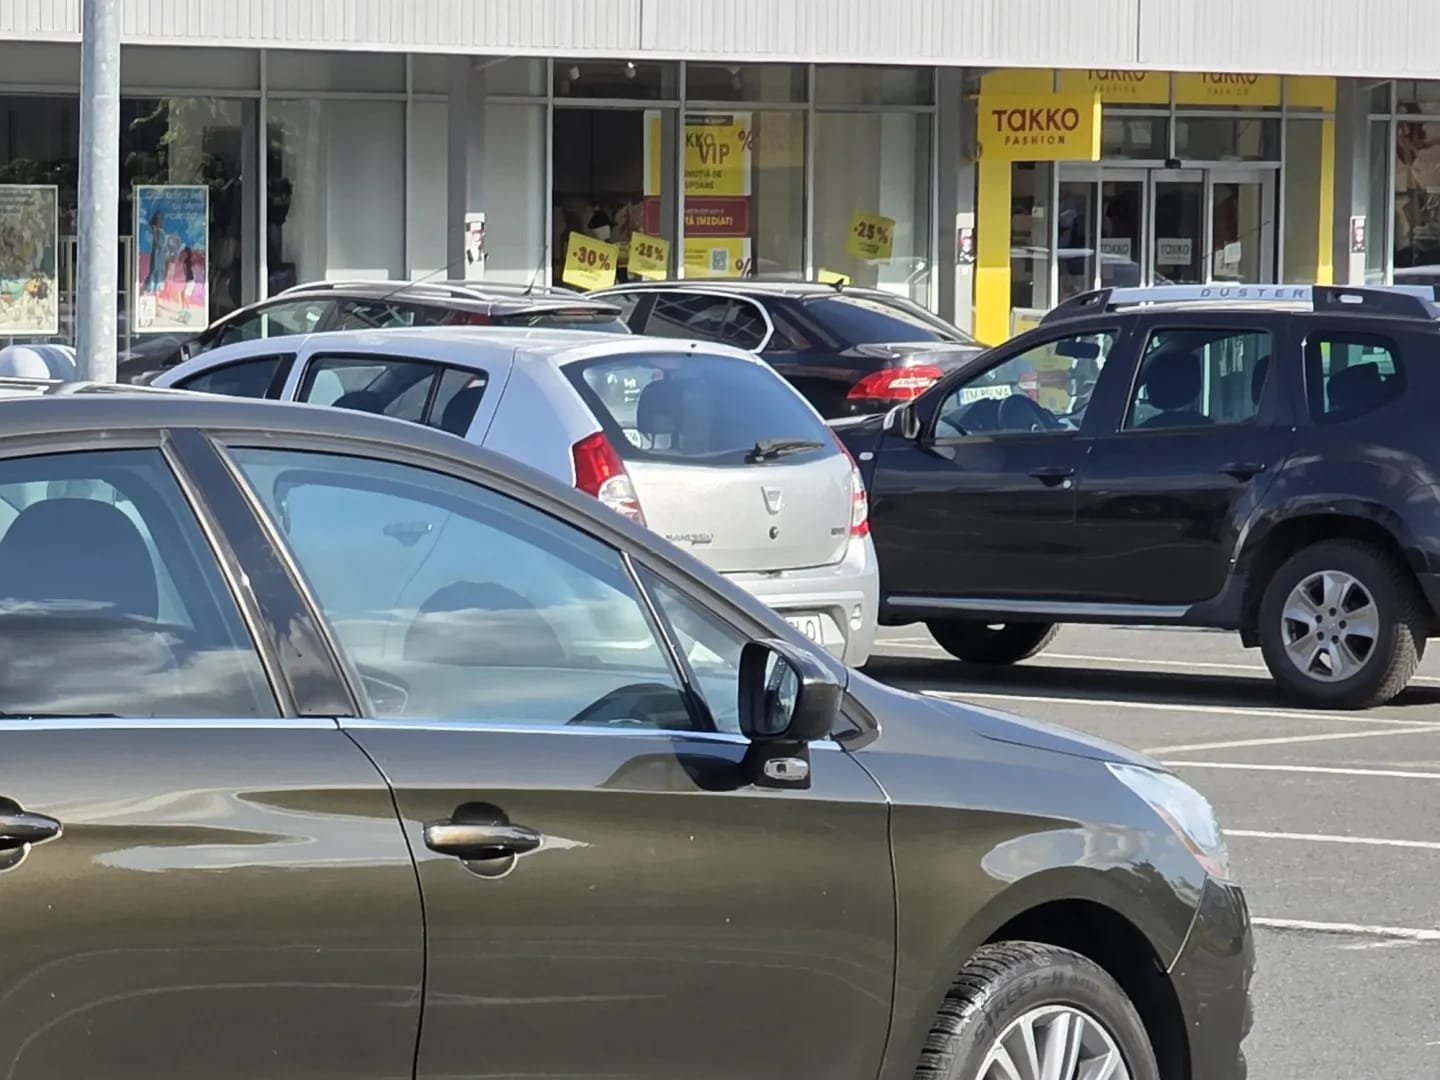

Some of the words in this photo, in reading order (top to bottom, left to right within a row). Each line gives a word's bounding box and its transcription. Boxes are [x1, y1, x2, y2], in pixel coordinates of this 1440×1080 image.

[685, 132, 715, 149] KKO
[1005, 135, 1065, 146] FASHION
[699, 143, 730, 165] VIP
[853, 220, 889, 245] -25%
[573, 246, 611, 271] -30%
[1200, 288, 1305, 298] DUSTER
